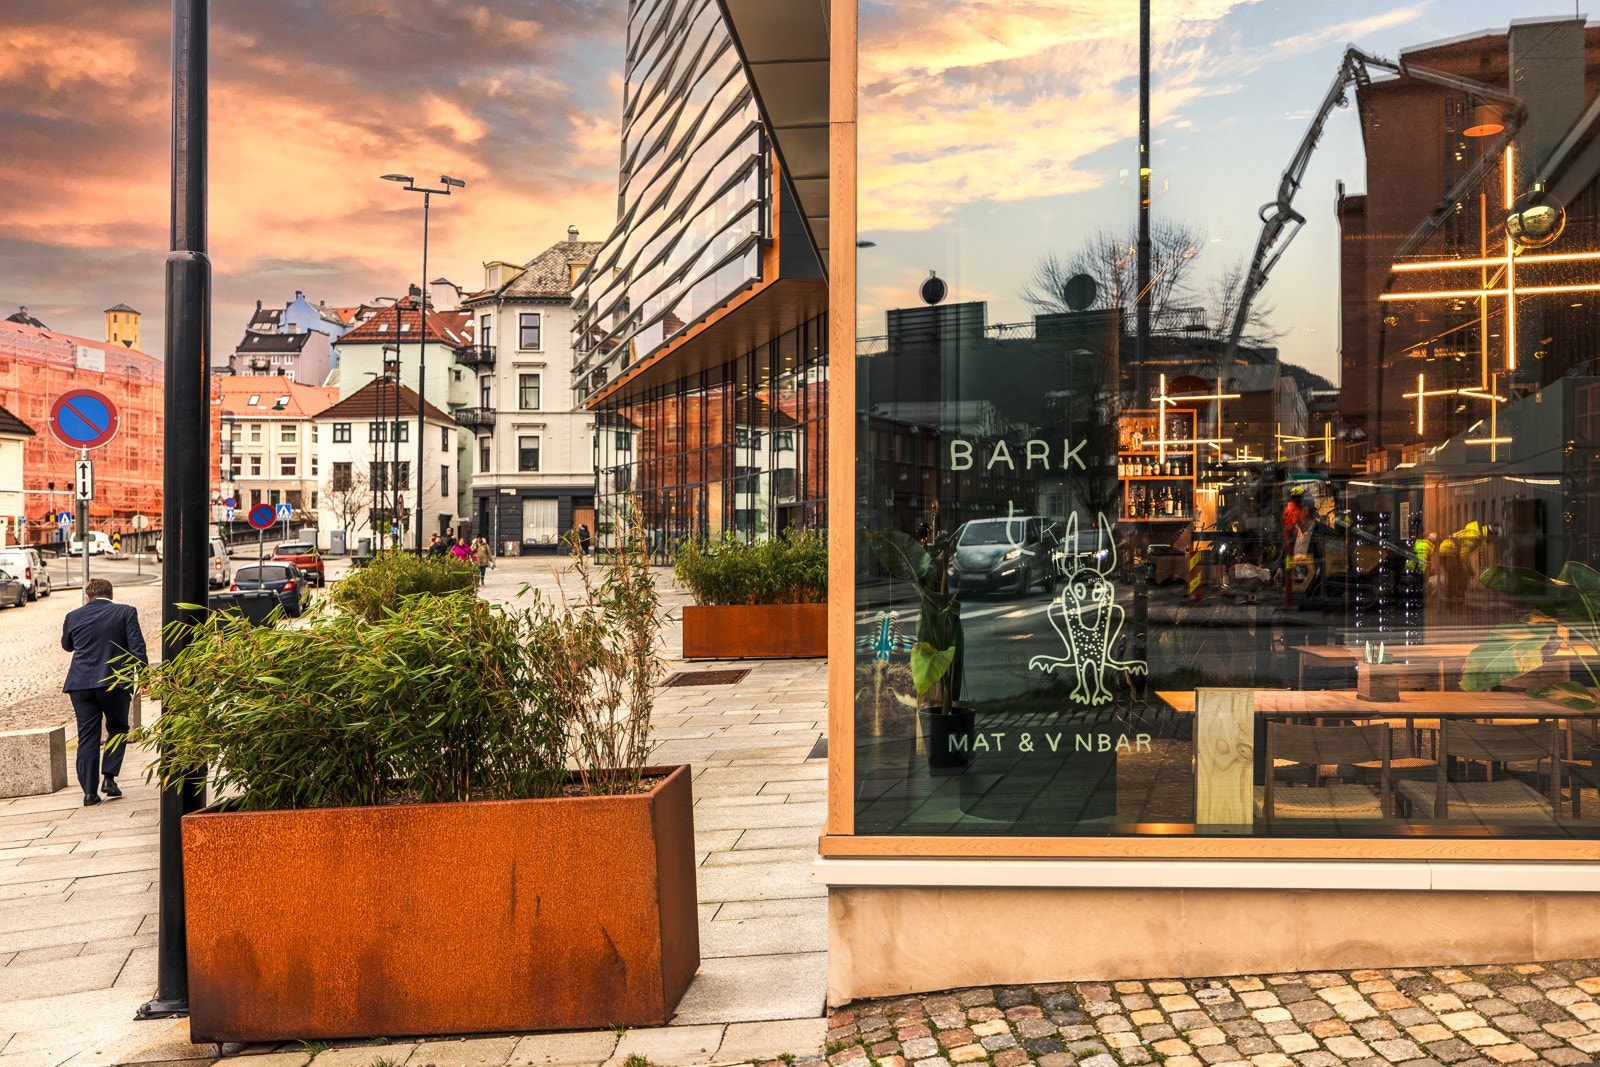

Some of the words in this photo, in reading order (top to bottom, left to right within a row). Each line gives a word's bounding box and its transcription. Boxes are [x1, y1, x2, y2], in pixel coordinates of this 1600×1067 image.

[950, 439, 1088, 470] BARK
[948, 733, 1006, 752] MAT
[1018, 733, 1035, 752] &
